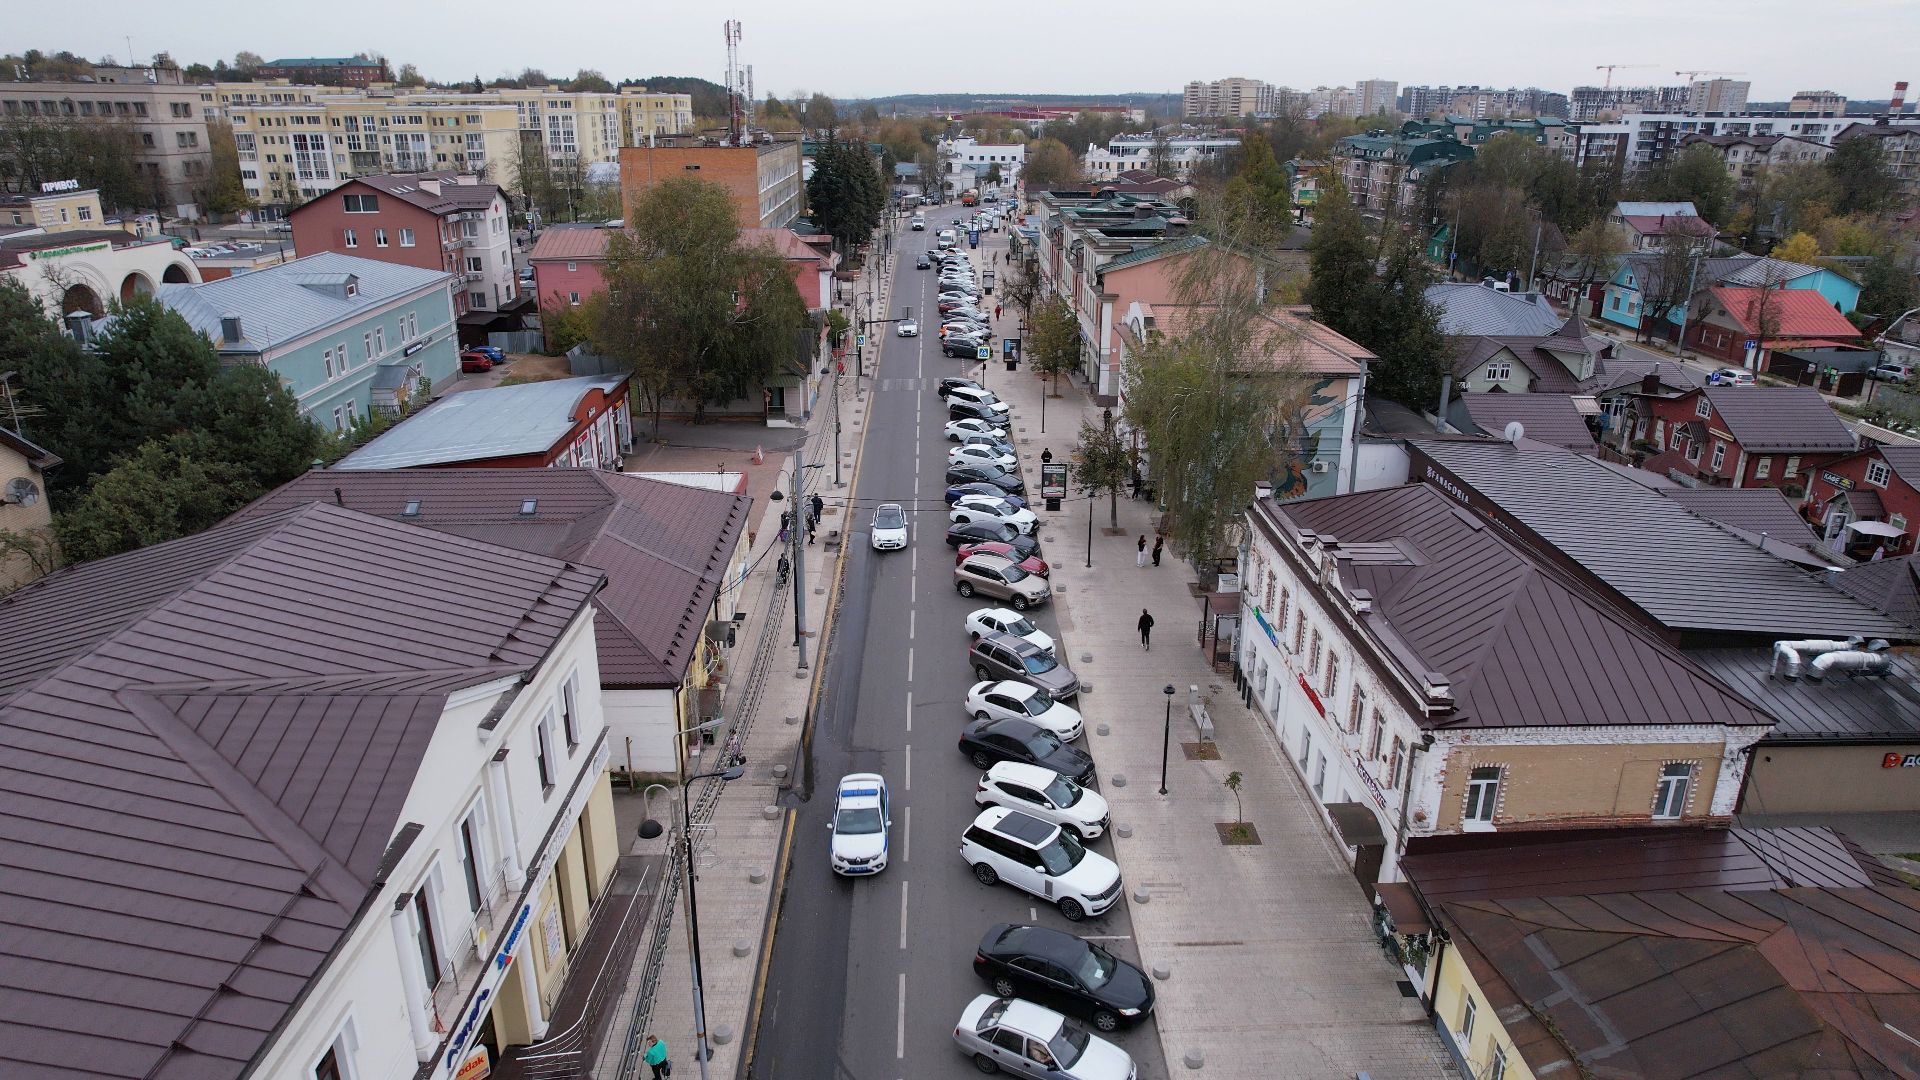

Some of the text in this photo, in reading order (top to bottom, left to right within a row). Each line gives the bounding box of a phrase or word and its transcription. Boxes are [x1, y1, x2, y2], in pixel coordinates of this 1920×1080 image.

[42, 179, 79, 192] ПРИВОЗ
[1431, 470, 1469, 504] FANAGORIA
[1824, 473, 1840, 484] КАФЕ
[455, 1056, 485, 1078] odak
